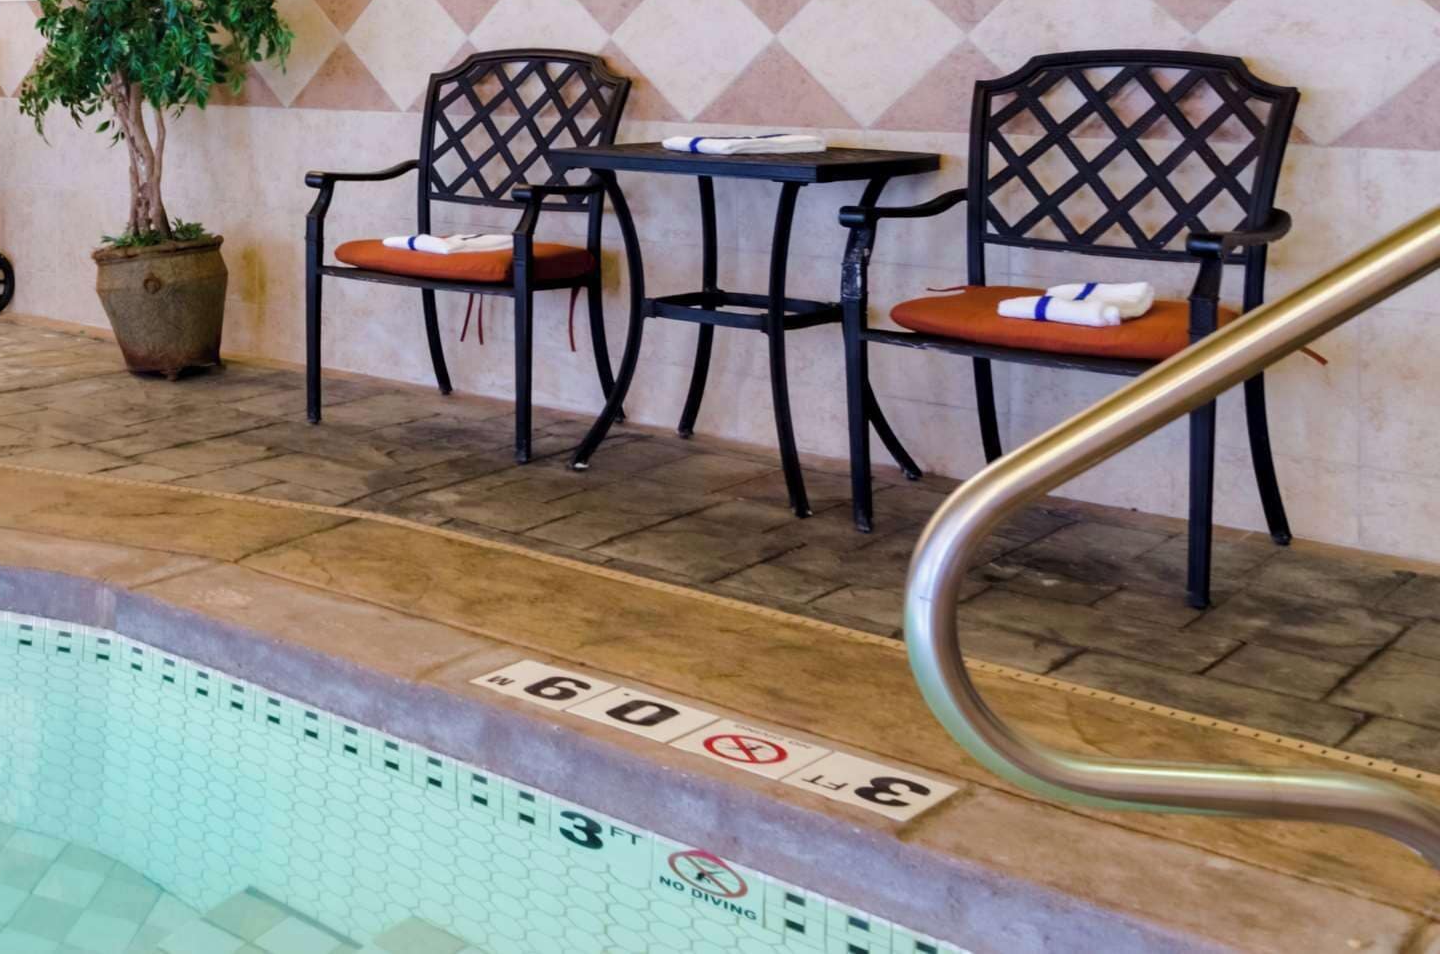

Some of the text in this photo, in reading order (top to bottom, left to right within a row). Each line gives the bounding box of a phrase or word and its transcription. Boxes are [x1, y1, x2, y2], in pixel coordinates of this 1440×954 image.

[800, 774, 849, 791] FT
[854, 776, 932, 808] 3
[559, 810, 643, 850] 3 FT
[659, 875, 758, 921] NO DIVING
